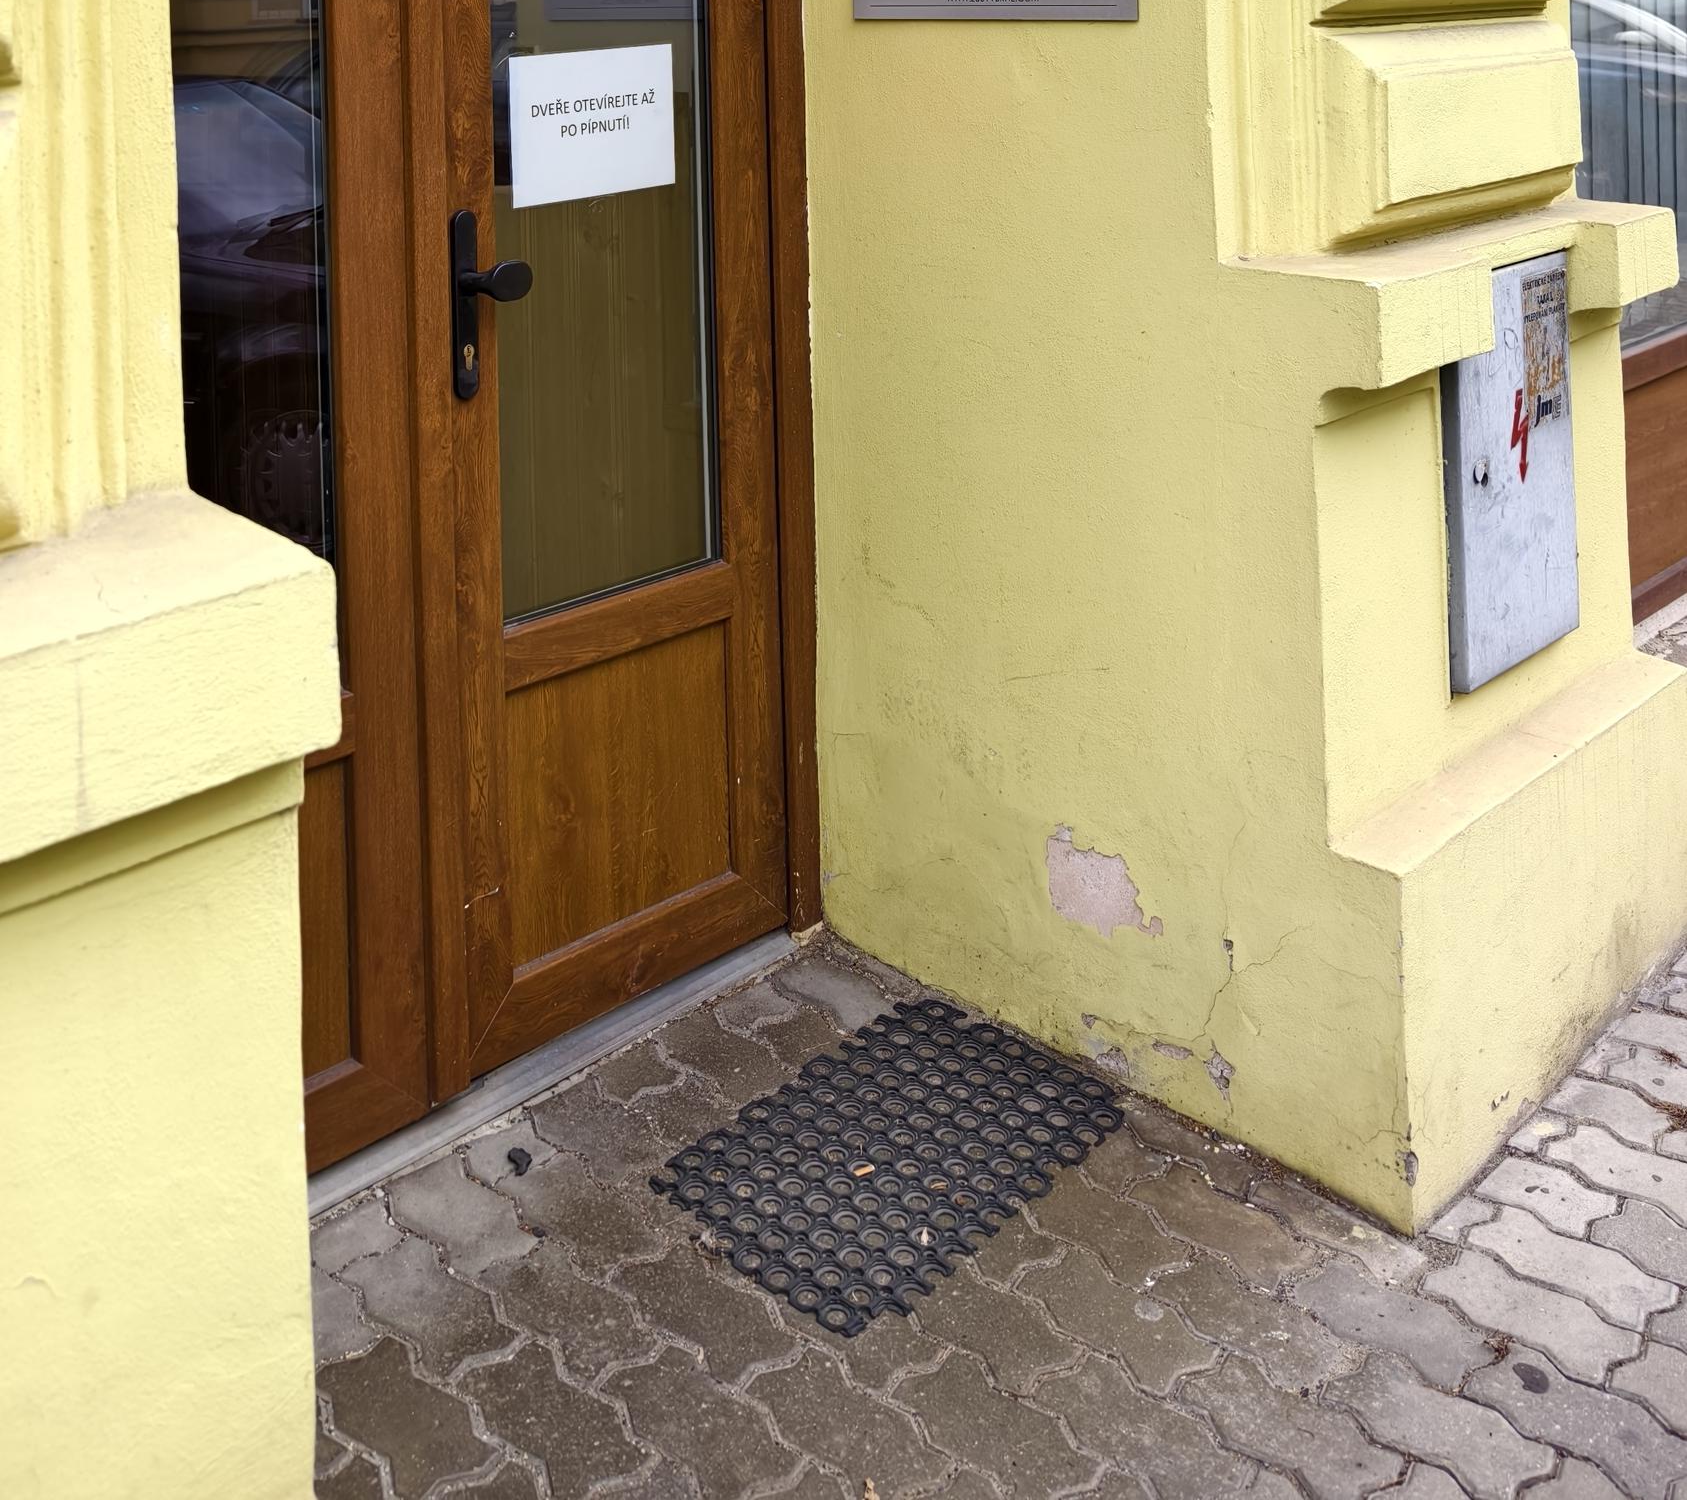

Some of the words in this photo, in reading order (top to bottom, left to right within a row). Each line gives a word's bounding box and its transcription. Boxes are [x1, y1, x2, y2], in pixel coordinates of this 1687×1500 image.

[531, 100, 571, 118] DVEŘE
[573, 92, 638, 114] OTEVÍREJTE
[641, 88, 656, 105] AŽ
[560, 122, 578, 139] PO
[580, 114, 631, 136] PÍPNUTÍ!
